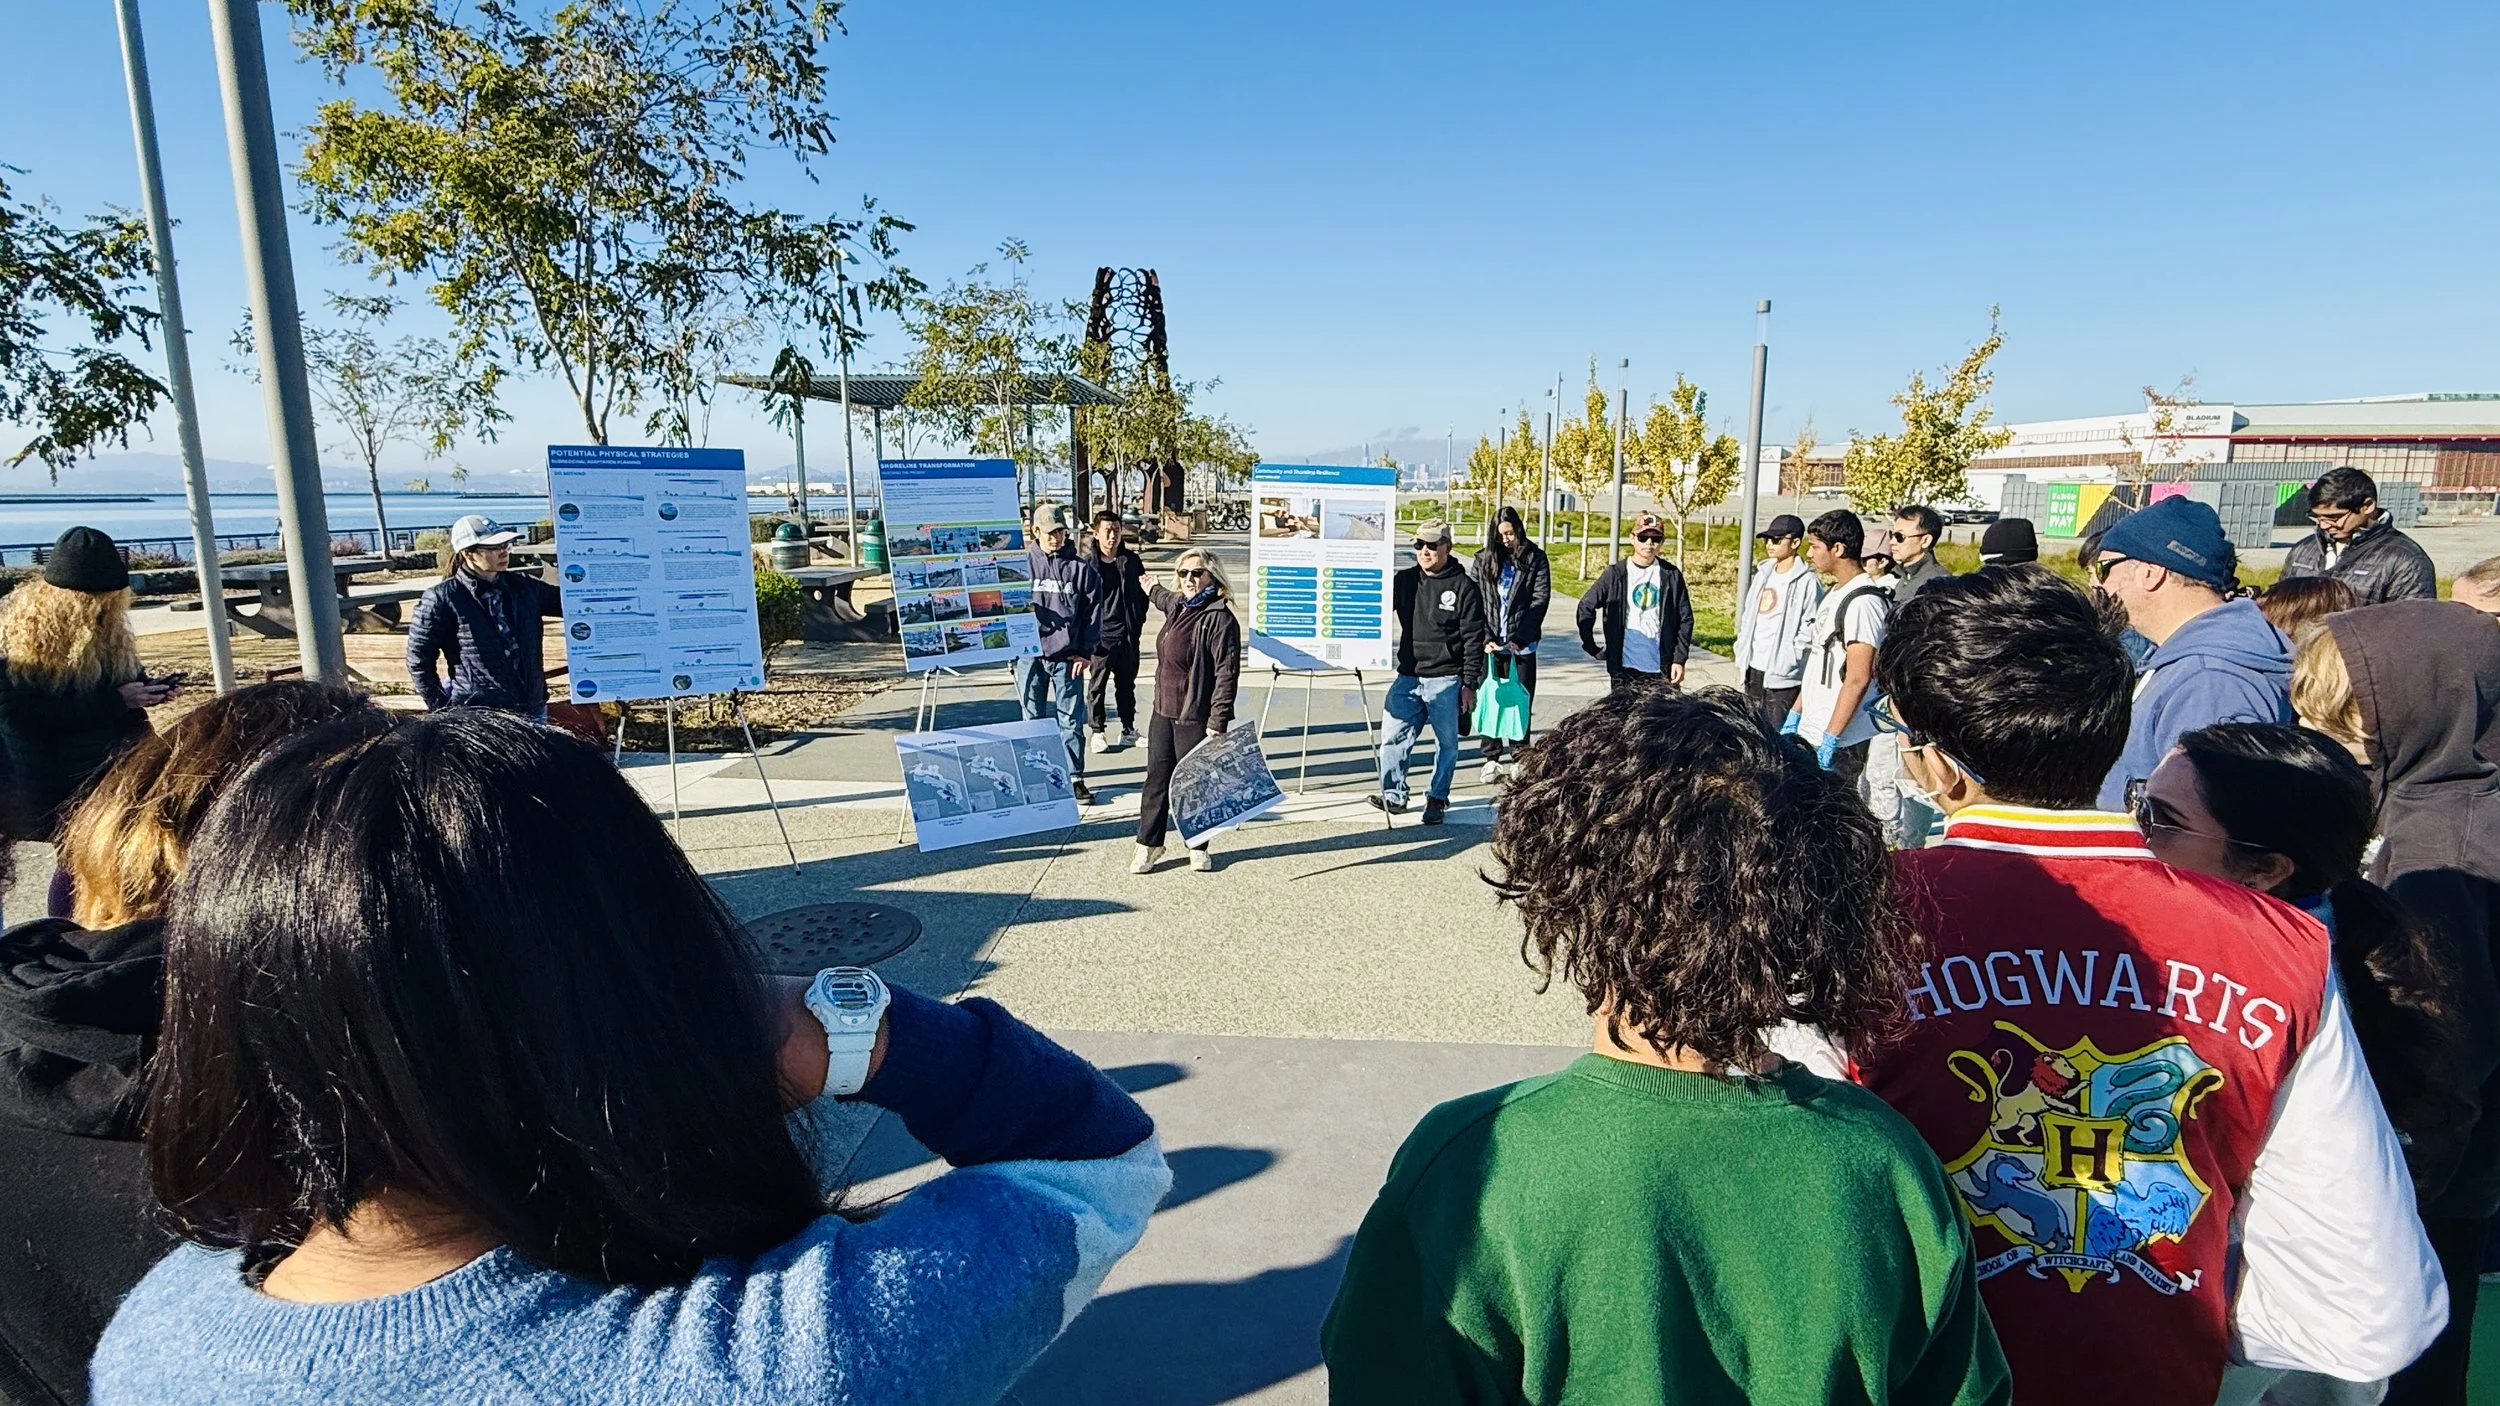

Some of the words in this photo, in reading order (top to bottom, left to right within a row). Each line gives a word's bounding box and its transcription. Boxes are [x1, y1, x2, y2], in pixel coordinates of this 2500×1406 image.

[550, 449, 597, 457] POTENTIAL
[599, 450, 639, 458] PHYSICAL
[640, 451, 690, 459] STRATEGIES
[2050, 501, 2076, 515] RUN
[2049, 515, 2074, 528] WAY
[2057, 1124, 2110, 1182] H
[2006, 1249, 2019, 1262] OF
[2044, 1256, 2107, 1269] WITCHCRAFT
[2119, 1252, 2138, 1265] AND
[2140, 1261, 2176, 1292] WIZARDRY
